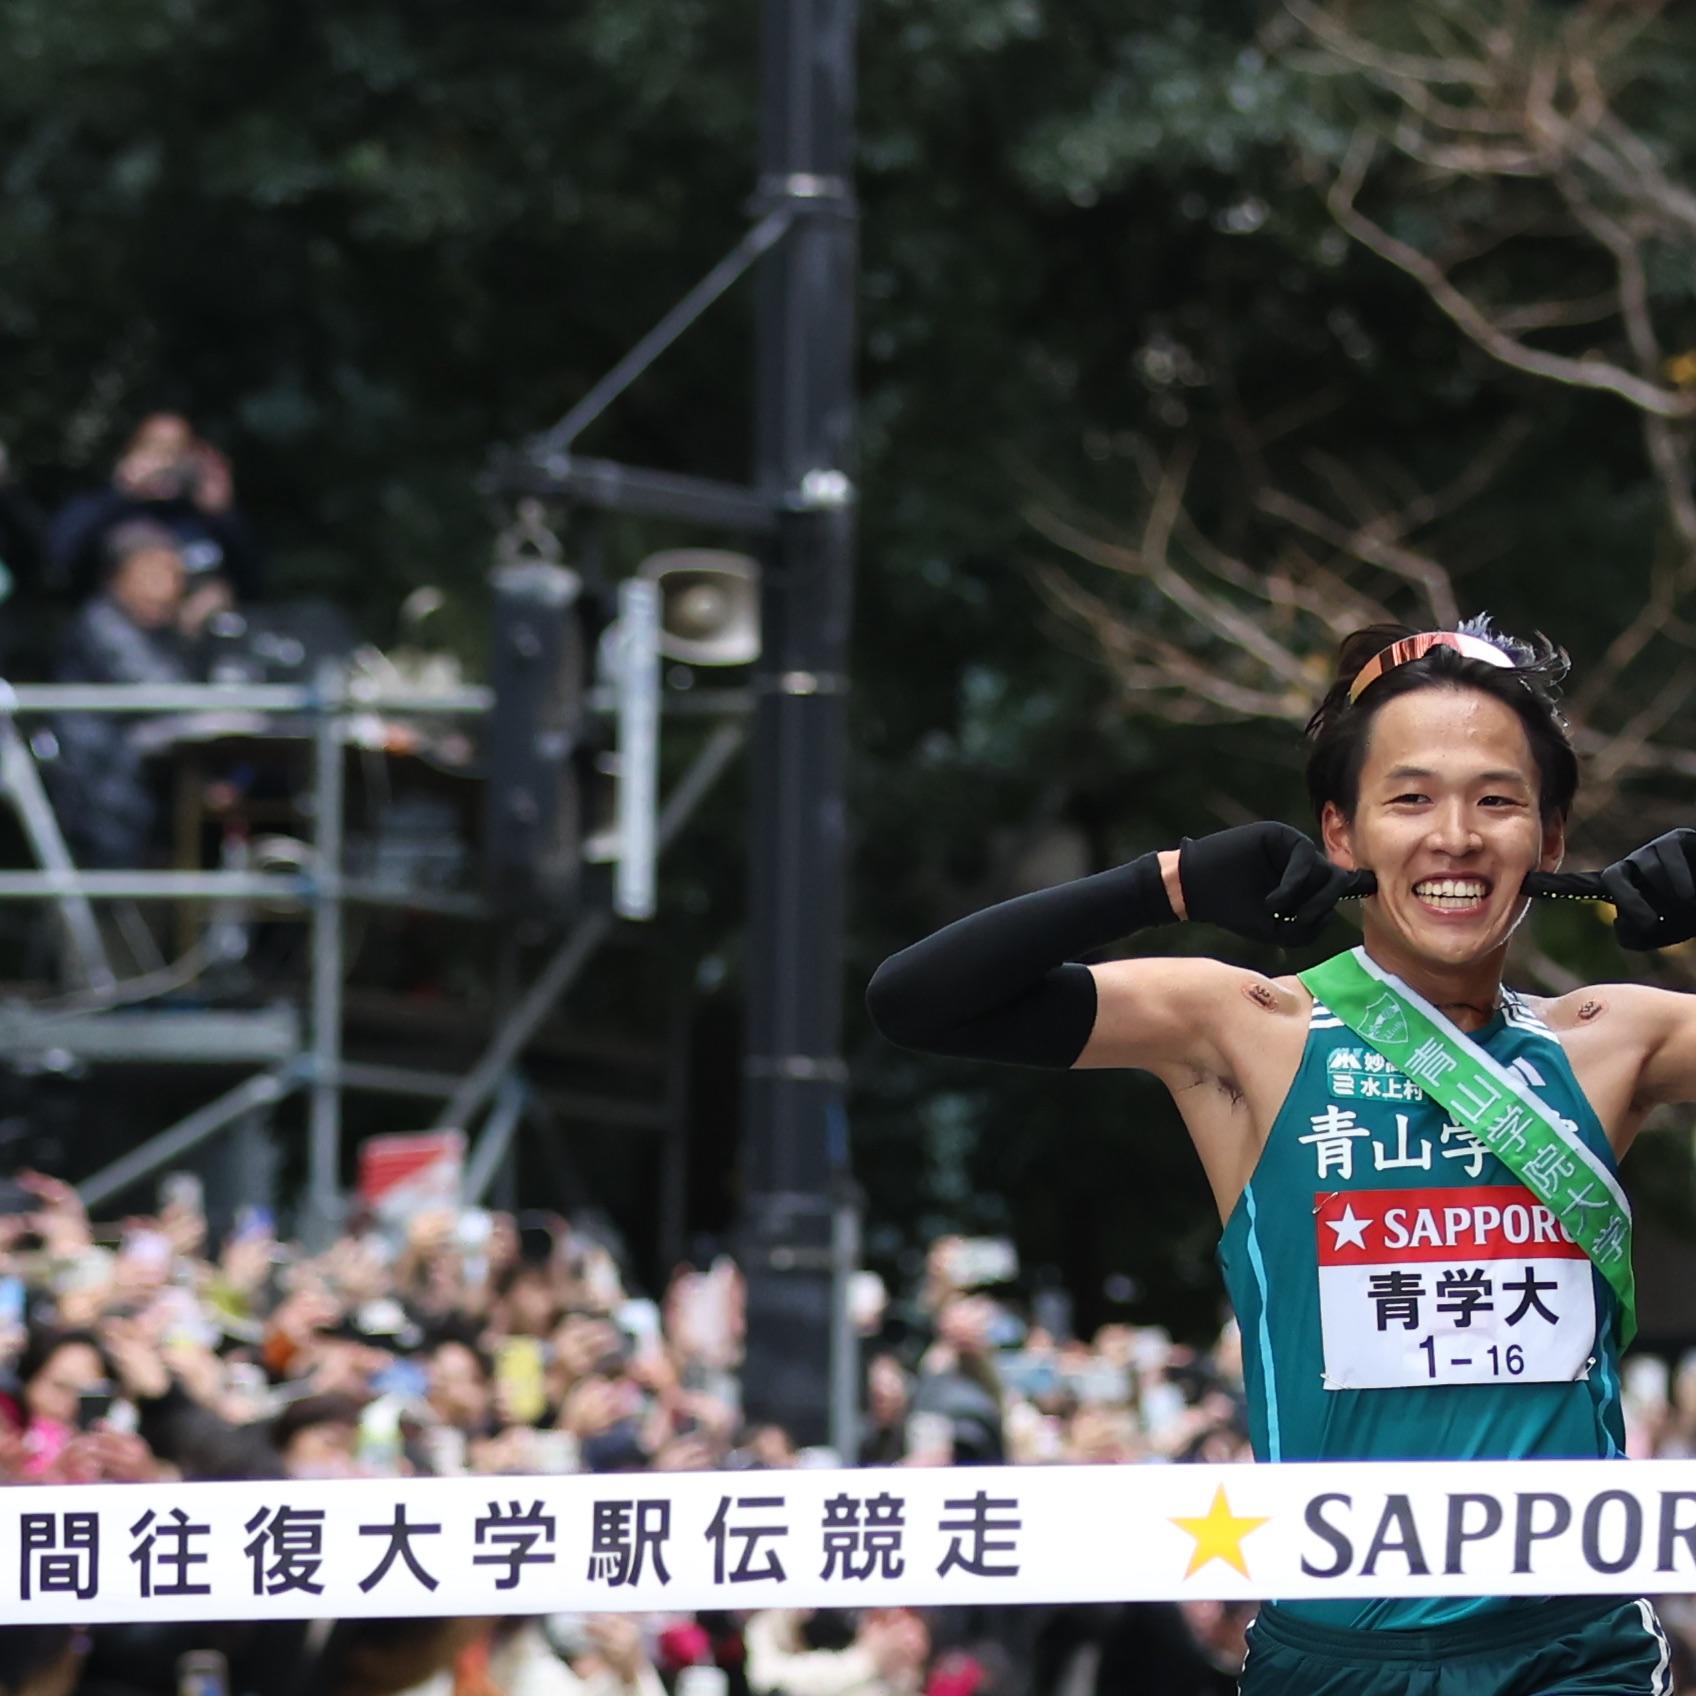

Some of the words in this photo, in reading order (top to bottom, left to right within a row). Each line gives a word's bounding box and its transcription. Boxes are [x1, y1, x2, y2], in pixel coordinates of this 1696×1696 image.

[1360, 1077, 1422, 1101] 水上村
[1298, 1104, 1578, 1180] 青山学
[1367, 1266, 1560, 1332] 青学大
